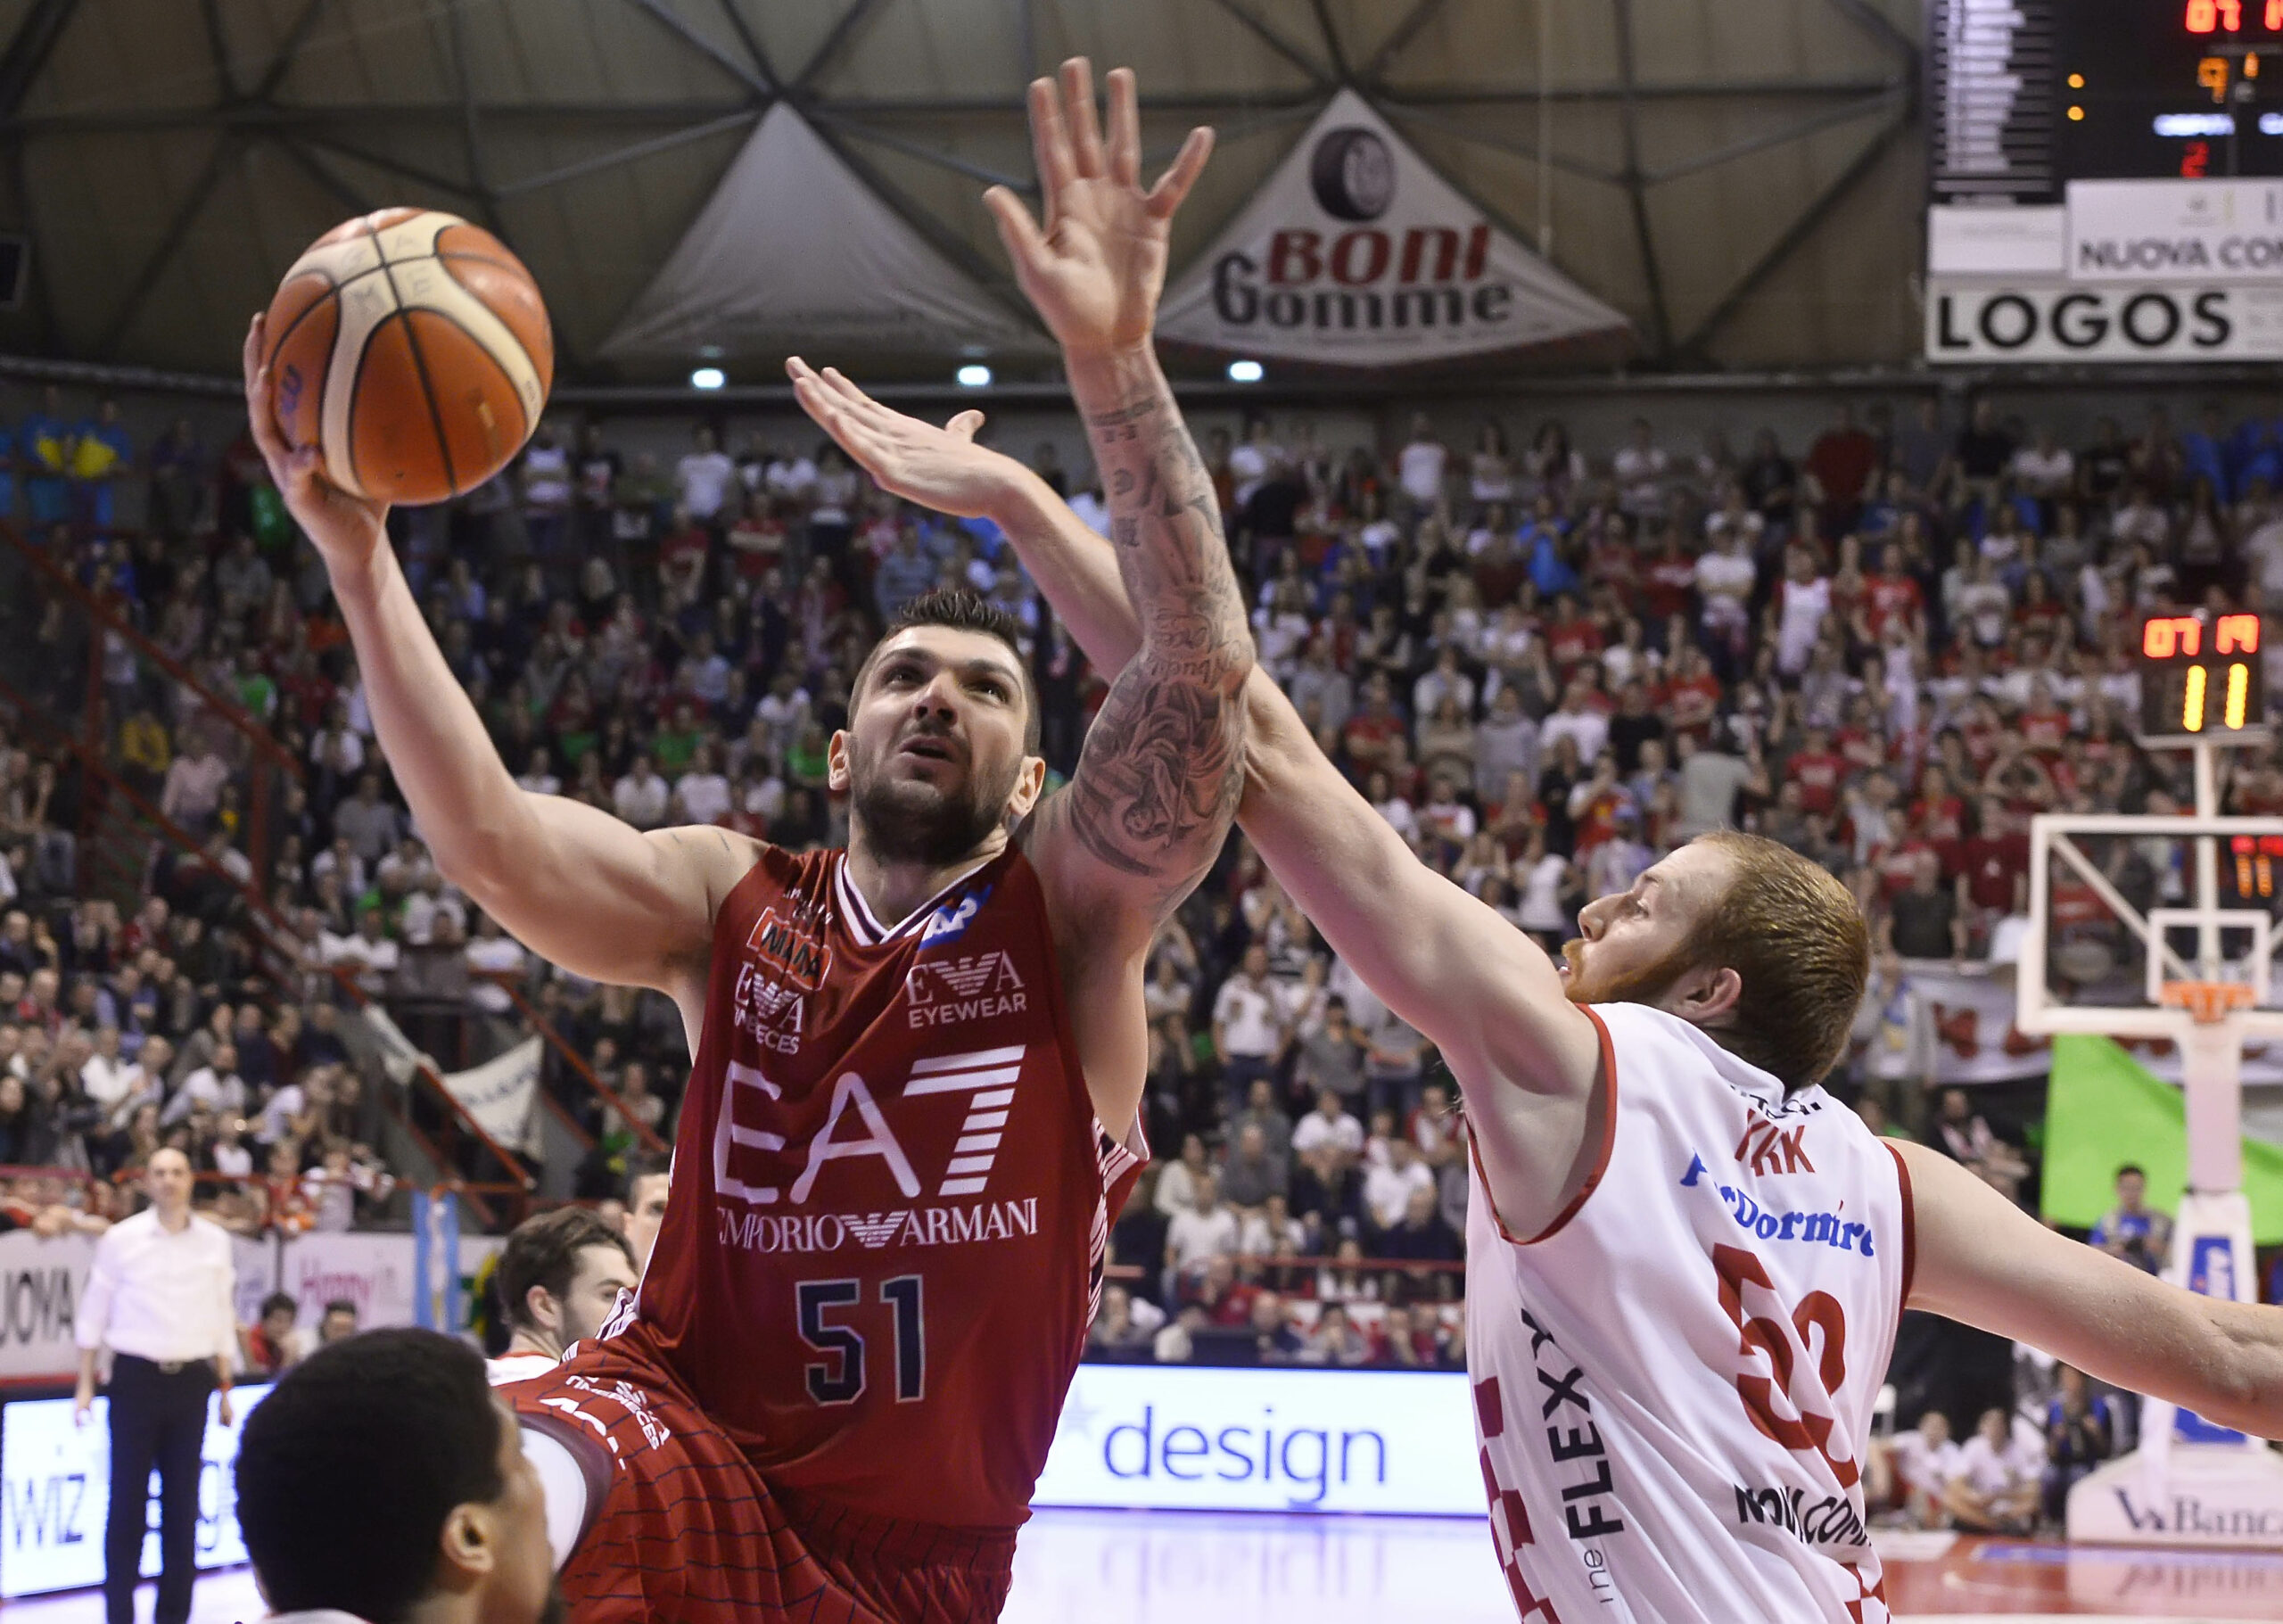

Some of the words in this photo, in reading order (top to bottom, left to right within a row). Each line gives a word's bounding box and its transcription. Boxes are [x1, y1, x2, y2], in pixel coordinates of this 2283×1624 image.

[1267, 224, 1490, 286] BONI
[2080, 238, 2209, 269] NUOVA
[1214, 252, 1511, 327] Gomme
[1938, 292, 2232, 349] LOGOS
[908, 992, 1027, 1029] EYEWEAR
[713, 1044, 1026, 1205] EA7
[717, 1206, 846, 1253] MPORIO
[899, 1198, 1038, 1247] ARMANI
[795, 1274, 925, 1406] 51
[1102, 1405, 1386, 1503] design
